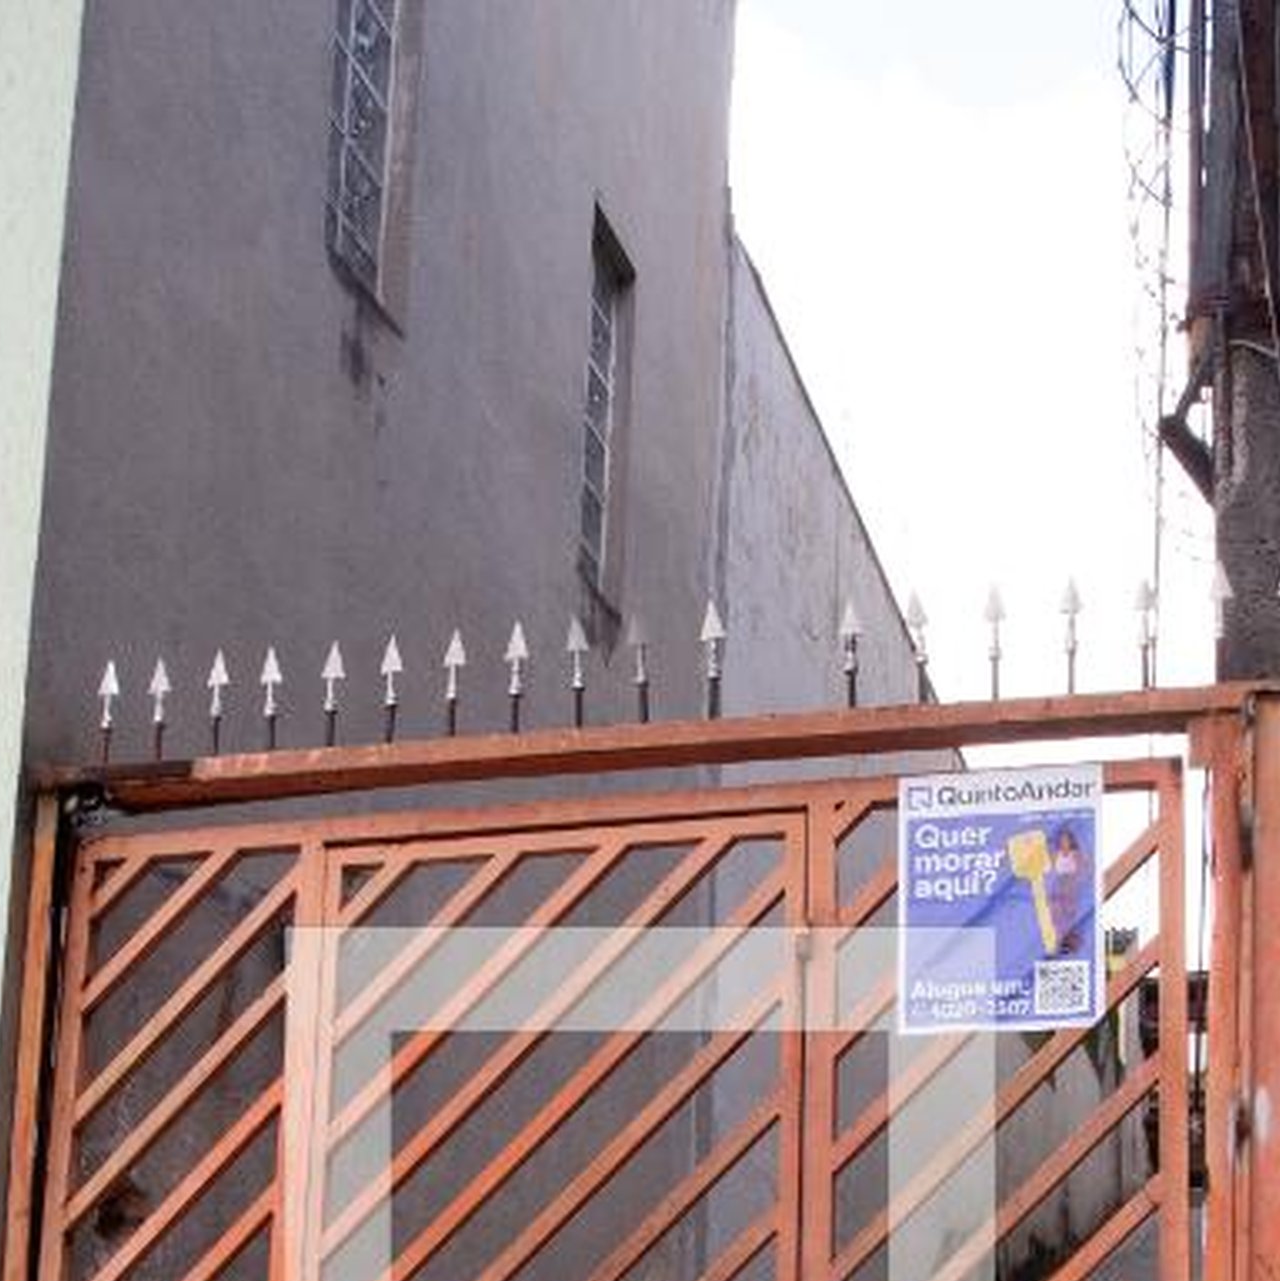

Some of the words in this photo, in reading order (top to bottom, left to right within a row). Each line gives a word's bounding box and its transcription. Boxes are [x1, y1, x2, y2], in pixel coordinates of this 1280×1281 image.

[937, 779, 1094, 806] QuintoAndar
[914, 824, 993, 849] Quer
[913, 849, 1006, 874] morar
[913, 869, 998, 901] aqui?
